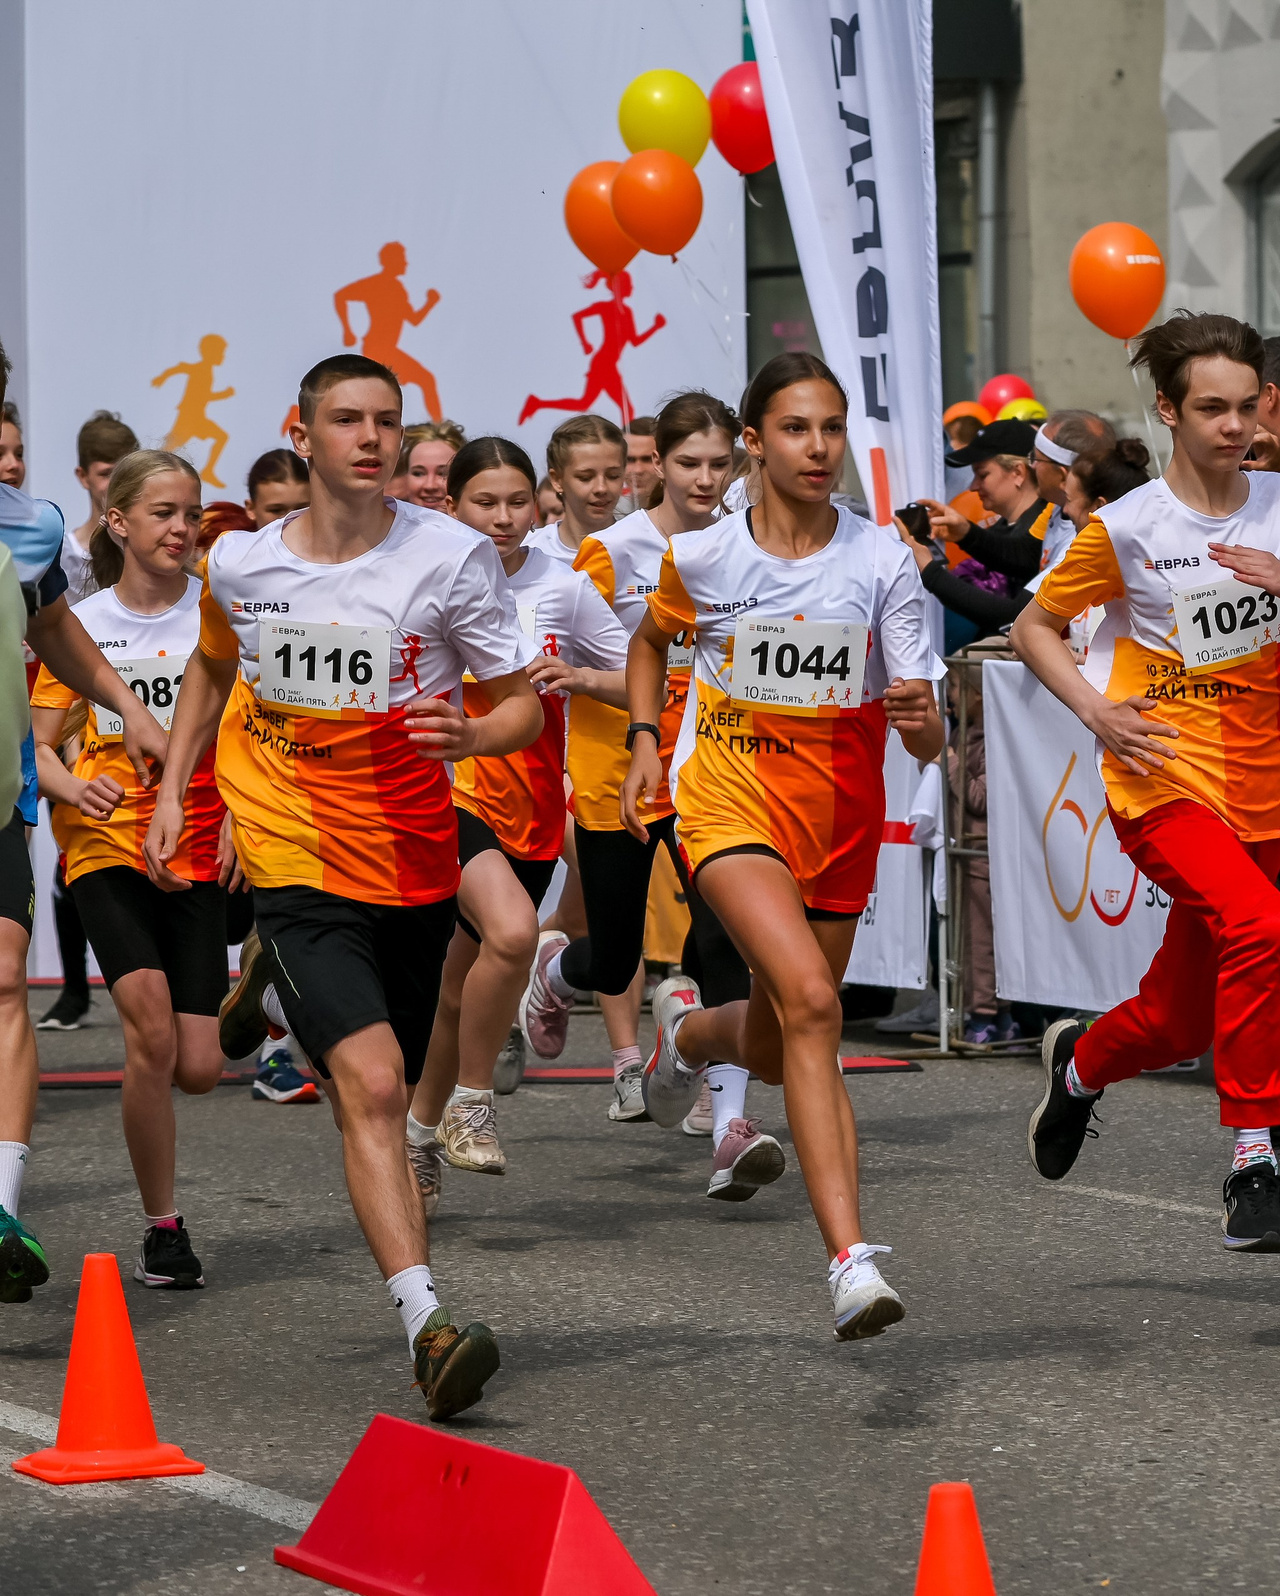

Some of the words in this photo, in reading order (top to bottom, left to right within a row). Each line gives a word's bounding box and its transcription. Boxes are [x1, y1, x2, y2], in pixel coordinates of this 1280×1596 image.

[1155, 557, 1201, 570] ЕВРАЗ
[1191, 589, 1217, 601] ЕВРАЗ
[244, 602, 290, 613] ЕВРАЗ
[1192, 590, 1278, 640] 1023
[278, 627, 306, 637] ЕВРАЗ
[756, 624, 785, 634] ЕВРАЗ
[97, 640, 128, 650] ВРАЗ
[1195, 650, 1210, 663] 10
[1212, 650, 1229, 661] ДАЙ
[1229, 645, 1249, 657] ПЯТЬ
[274, 643, 373, 685] 1116
[750, 640, 851, 682] 1044
[272, 688, 286, 701] 10
[744, 685, 759, 699] 10
[1145, 680, 1186, 700] ДАЙ
[287, 694, 304, 704] ДАЙ
[306, 697, 327, 707] ПЯТЬ
[760, 692, 780, 702] ДАЙ
[781, 695, 804, 704] ПЯТЬ
[108, 720, 121, 732] 10
[729, 735, 796, 754] ПЯТЬ!
[1104, 889, 1121, 904] ЛЕТ
[1145, 879, 1173, 908] ЗС
